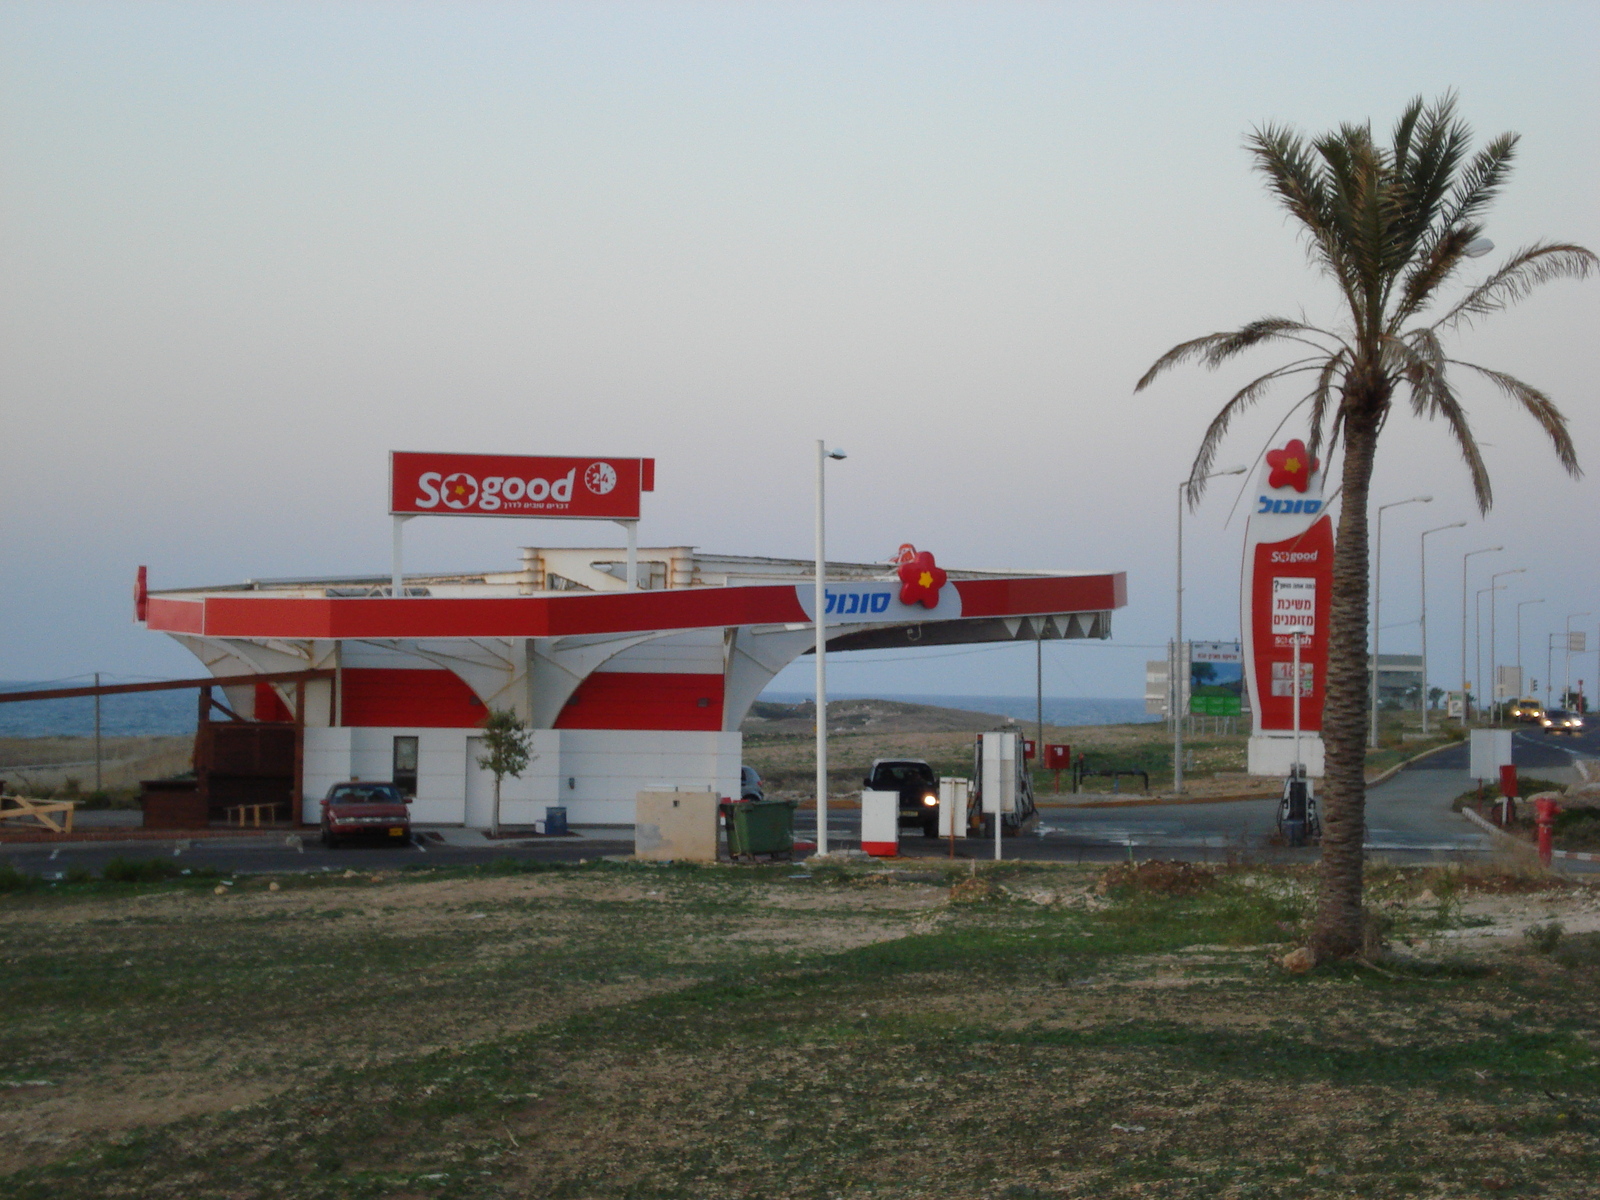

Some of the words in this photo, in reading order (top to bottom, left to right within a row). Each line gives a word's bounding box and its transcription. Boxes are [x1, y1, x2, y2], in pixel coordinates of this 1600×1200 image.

[593, 473, 608, 484] 24
[1257, 496, 1323, 514] סונול
[825, 589, 891, 614] סונול
[1277, 599, 1311, 610] משיכת
[1273, 615, 1314, 626] מזומנים
